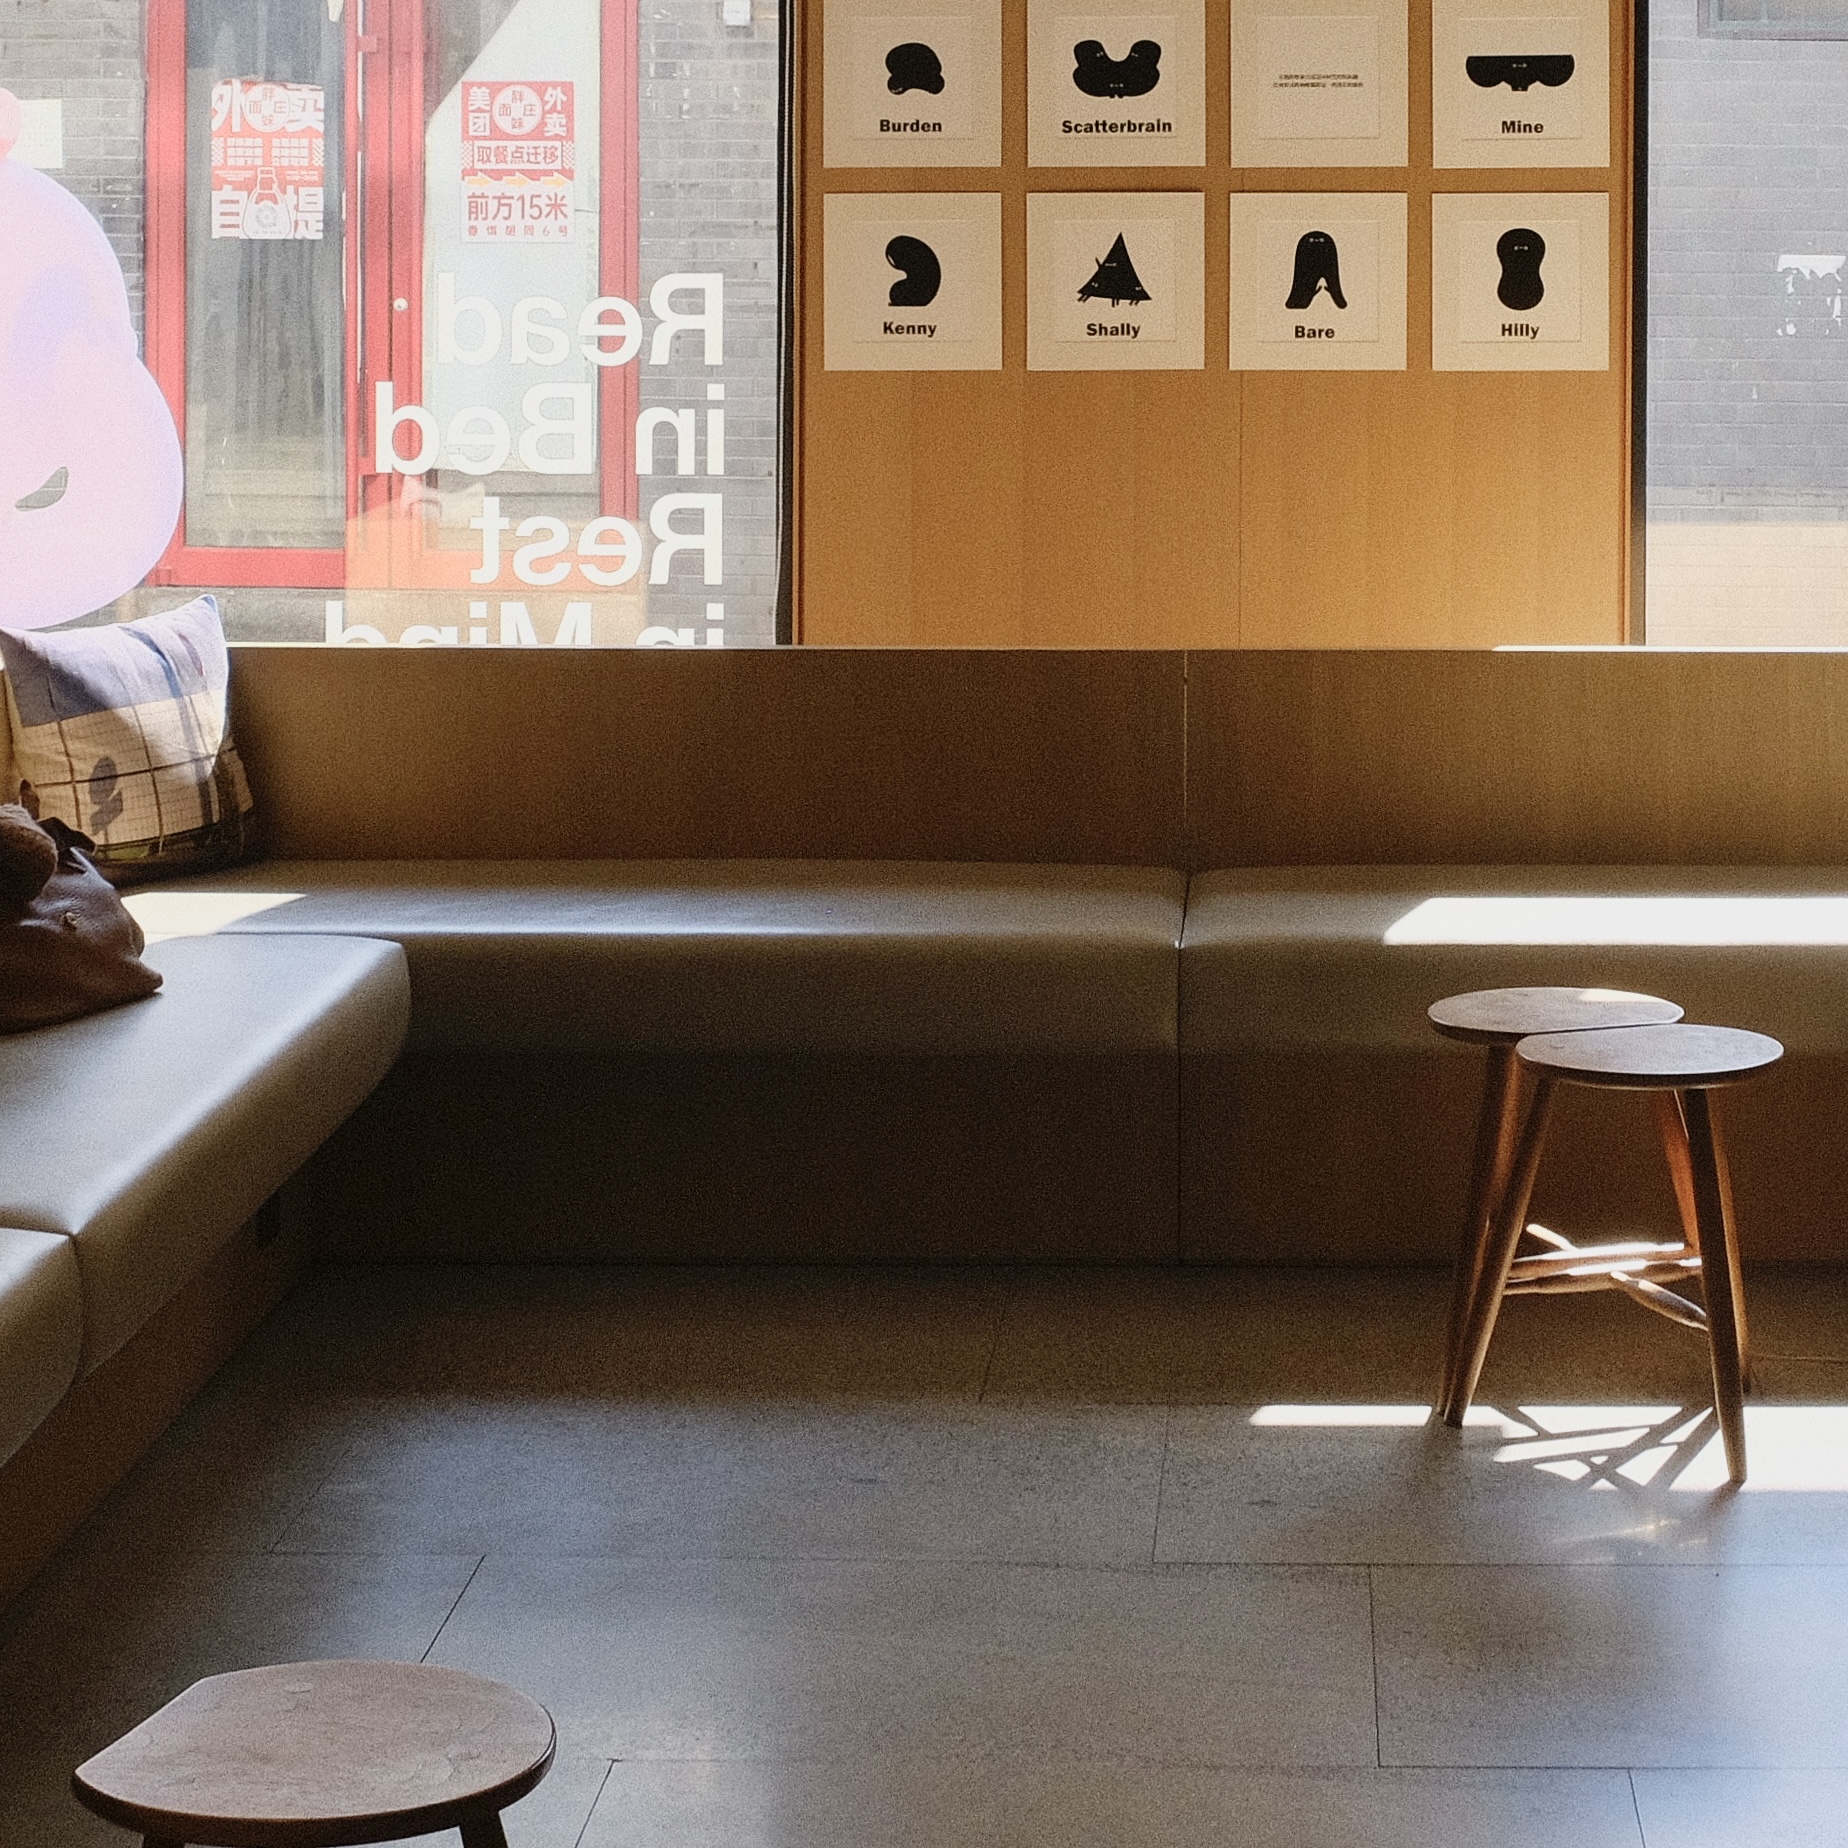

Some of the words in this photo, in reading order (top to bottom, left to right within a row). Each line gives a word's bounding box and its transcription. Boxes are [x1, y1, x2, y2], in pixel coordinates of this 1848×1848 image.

[468, 86, 491, 136] 美团
[544, 86, 567, 137] 外卖
[879, 119, 942, 133] Burden
[1062, 119, 1172, 134] Scatterbrain
[1501, 120, 1544, 133] Mine
[477, 145, 559, 165] 取餐点迁移
[467, 192, 568, 222] 前方15米
[883, 321, 936, 338] Kenny
[1086, 323, 1139, 339] Shally
[1294, 325, 1335, 338] Bare
[1501, 324, 1538, 339] Hilly
